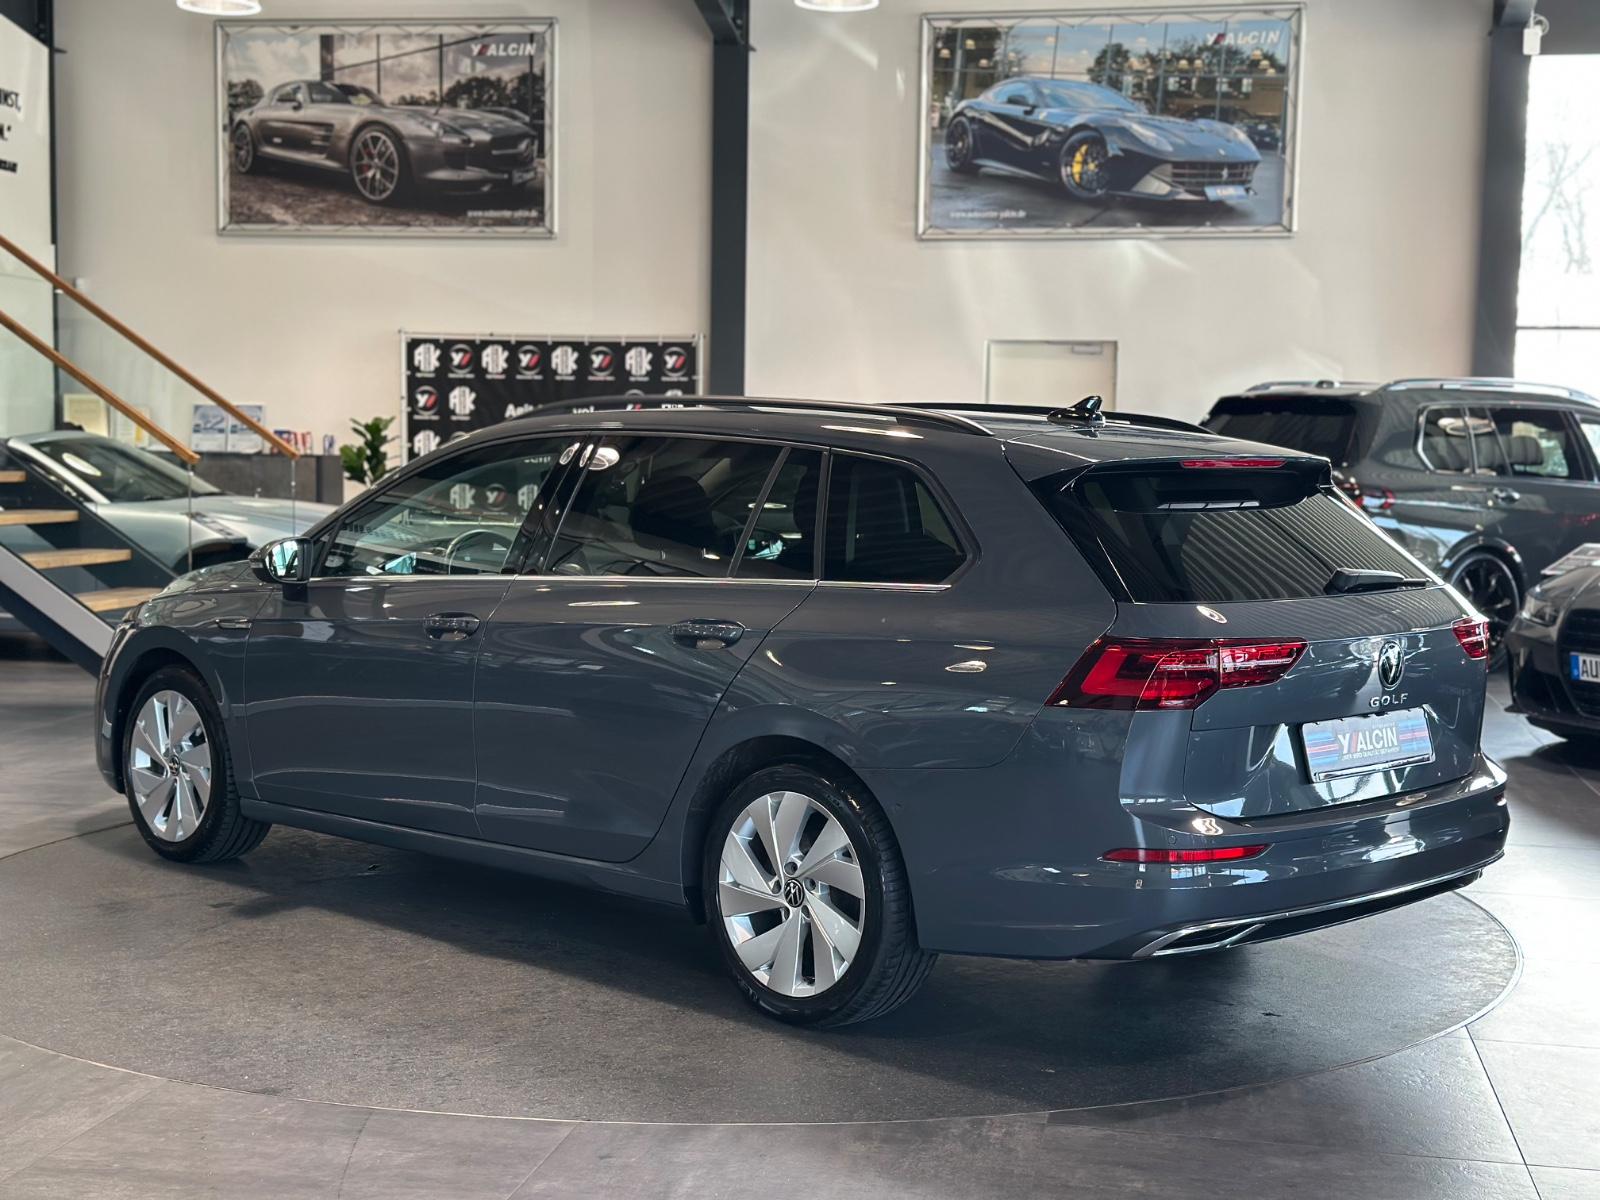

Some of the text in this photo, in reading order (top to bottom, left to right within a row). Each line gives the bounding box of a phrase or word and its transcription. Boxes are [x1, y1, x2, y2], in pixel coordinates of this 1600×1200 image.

[471, 43, 536, 56] YALCIN
[1581, 659, 1599, 678] AU
[1370, 693, 1408, 707] GOLF
[1338, 727, 1398, 755] YALCIN
